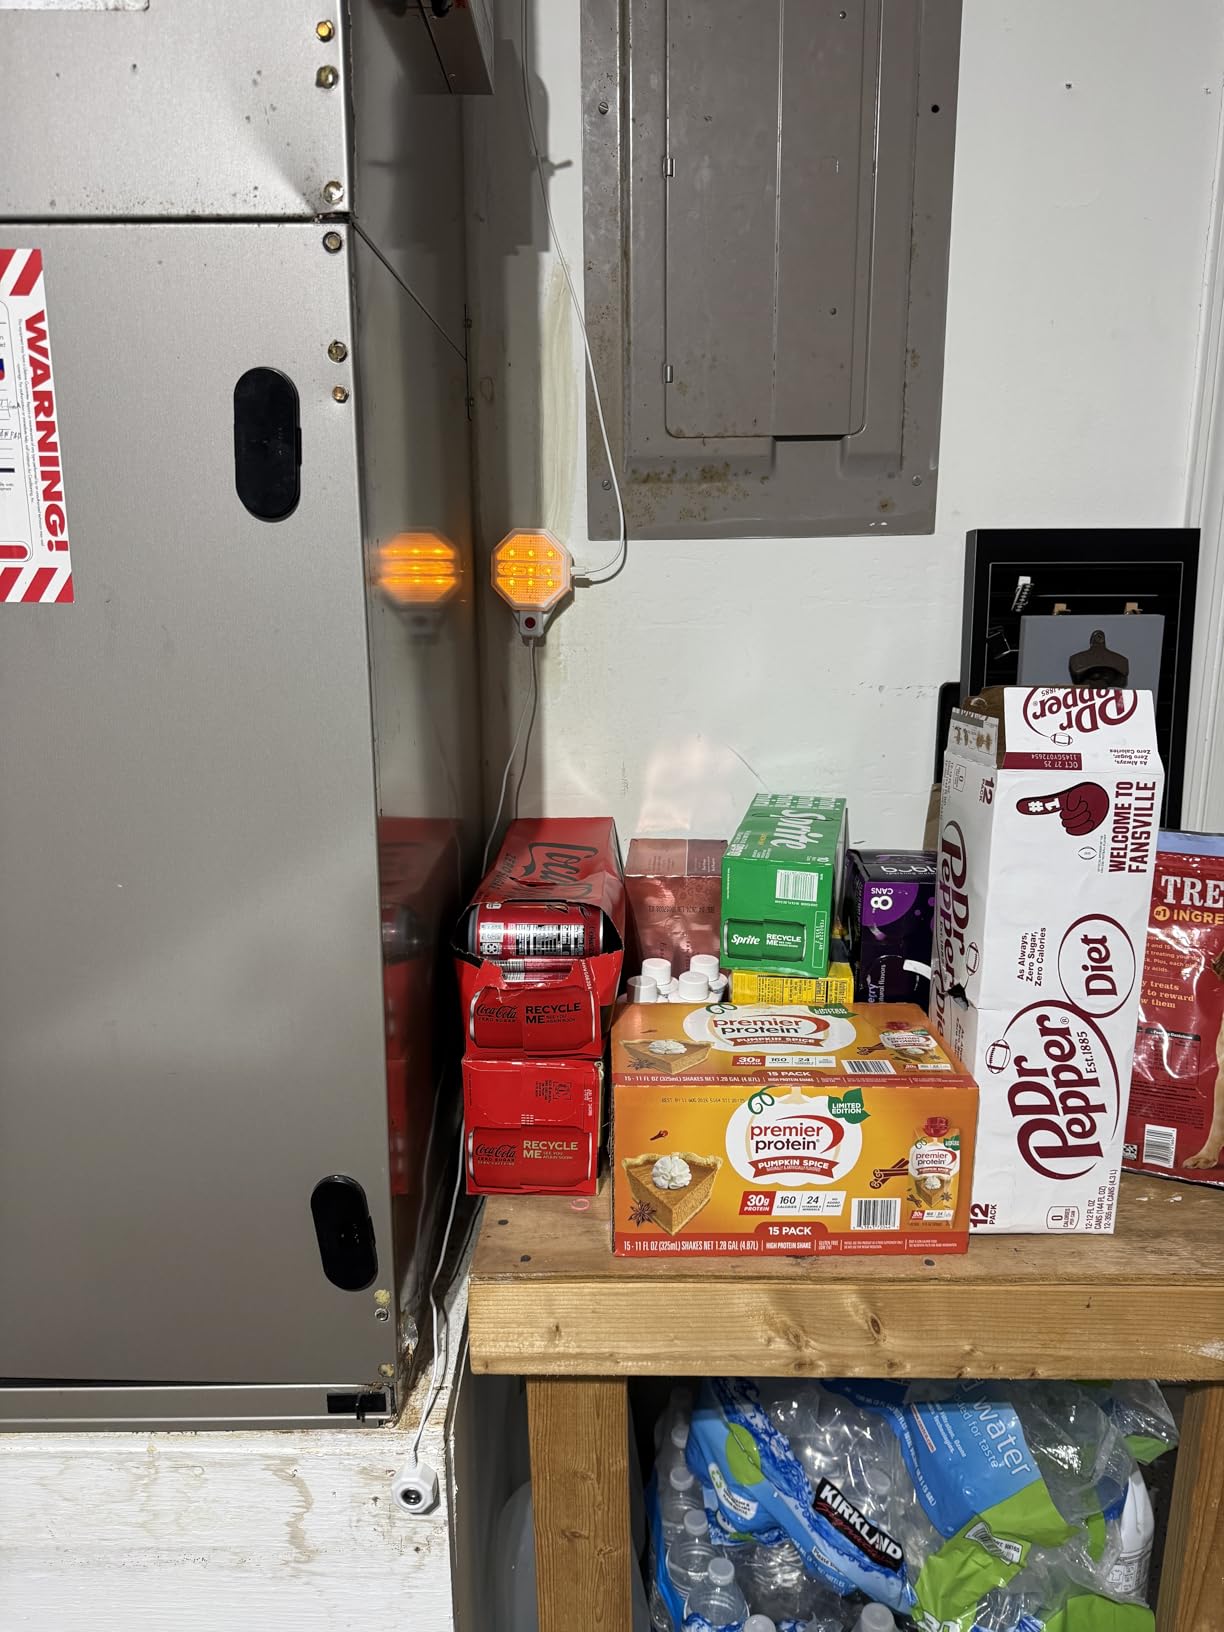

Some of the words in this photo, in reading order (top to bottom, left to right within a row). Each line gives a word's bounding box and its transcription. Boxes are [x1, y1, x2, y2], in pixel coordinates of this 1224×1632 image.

[25, 309, 69, 552] WARNING!
[1059, 702, 1099, 733] Dr
[1043, 760, 1052, 768] 25
[1054, 760, 1061, 768] 27
[1064, 760, 1078, 768] OCT
[982, 777, 995, 805] 12
[1115, 781, 1133, 796] TO
[1027, 796, 1061, 813] #1
[769, 808, 827, 851] Sprite
[1127, 781, 1156, 874] FANSVILLE
[1108, 802, 1132, 873] WELCOME
[870, 887, 894, 895] CANS
[870, 895, 894, 910] 8
[940, 820, 968, 989] Pepper
[952, 889, 970, 956] Dr
[730, 933, 761, 946] Sprite
[766, 933, 802, 943] RECYCLE
[1036, 927, 1047, 964] Calories
[1017, 931, 1029, 968] Always,
[1028, 930, 1039, 963] Sugar,
[1080, 933, 1118, 997] Diet
[878, 964, 886, 985] flavors
[1016, 969, 1025, 981] As
[1025, 964, 1034, 982] Zero
[1034, 967, 1042, 987] Zero
[1150, 980, 1180, 991] treats
[1147, 988, 1157, 997] to
[1159, 992, 1194, 1003] reward
[476, 1003, 518, 1019] Coca-Cola
[525, 1002, 582, 1015] RECYCLE
[1151, 999, 1176, 1009] them
[525, 1015, 546, 1025] ME
[712, 1017, 803, 1028] premier
[721, 1024, 799, 1035] protein
[785, 1036, 816, 1044] SPICE
[1007, 1055, 1061, 1118] Dr
[1016, 1013, 1107, 1170] Pepper
[750, 1123, 824, 1141] premier
[475, 1143, 518, 1158] Coca-Cola
[523, 1140, 579, 1151] RECYCLE
[754, 1139, 818, 1154] protein
[523, 1150, 542, 1159] ME
[915, 1150, 948, 1160] premier
[917, 1158, 945, 1166] protein
[757, 1159, 800, 1169] PUMPKIN
[802, 1159, 830, 1170] SPICE
[746, 1194, 770, 1207] 30g
[780, 1195, 797, 1205] 160
[806, 1195, 819, 1205] 24
[1106, 1186, 1115, 1202] CANS
[969, 1202, 990, 1228] 12
[989, 1203, 997, 1225] PACK
[1094, 1215, 1103, 1230] CANS
[768, 1226, 780, 1236] 15
[782, 1226, 812, 1236] PACK
[623, 1240, 631, 1250] 15
[635, 1240, 642, 1250] 11
[642, 1240, 650, 1250] FL
[650, 1240, 658, 1250] OZ
[658, 1240, 681, 1251] (325mL)
[681, 1241, 703, 1251] SHAKES
[703, 1241, 714, 1250] NET
[715, 1240, 727, 1250] 1.28
[727, 1240, 739, 1250] GAL
[796, 1241, 811, 1249] SHAKE
[973, 1395, 1031, 1474] water
[969, 1420, 983, 1438] for
[979, 1439, 999, 1468] taste
[819, 1484, 903, 1561] KIRKLAND
